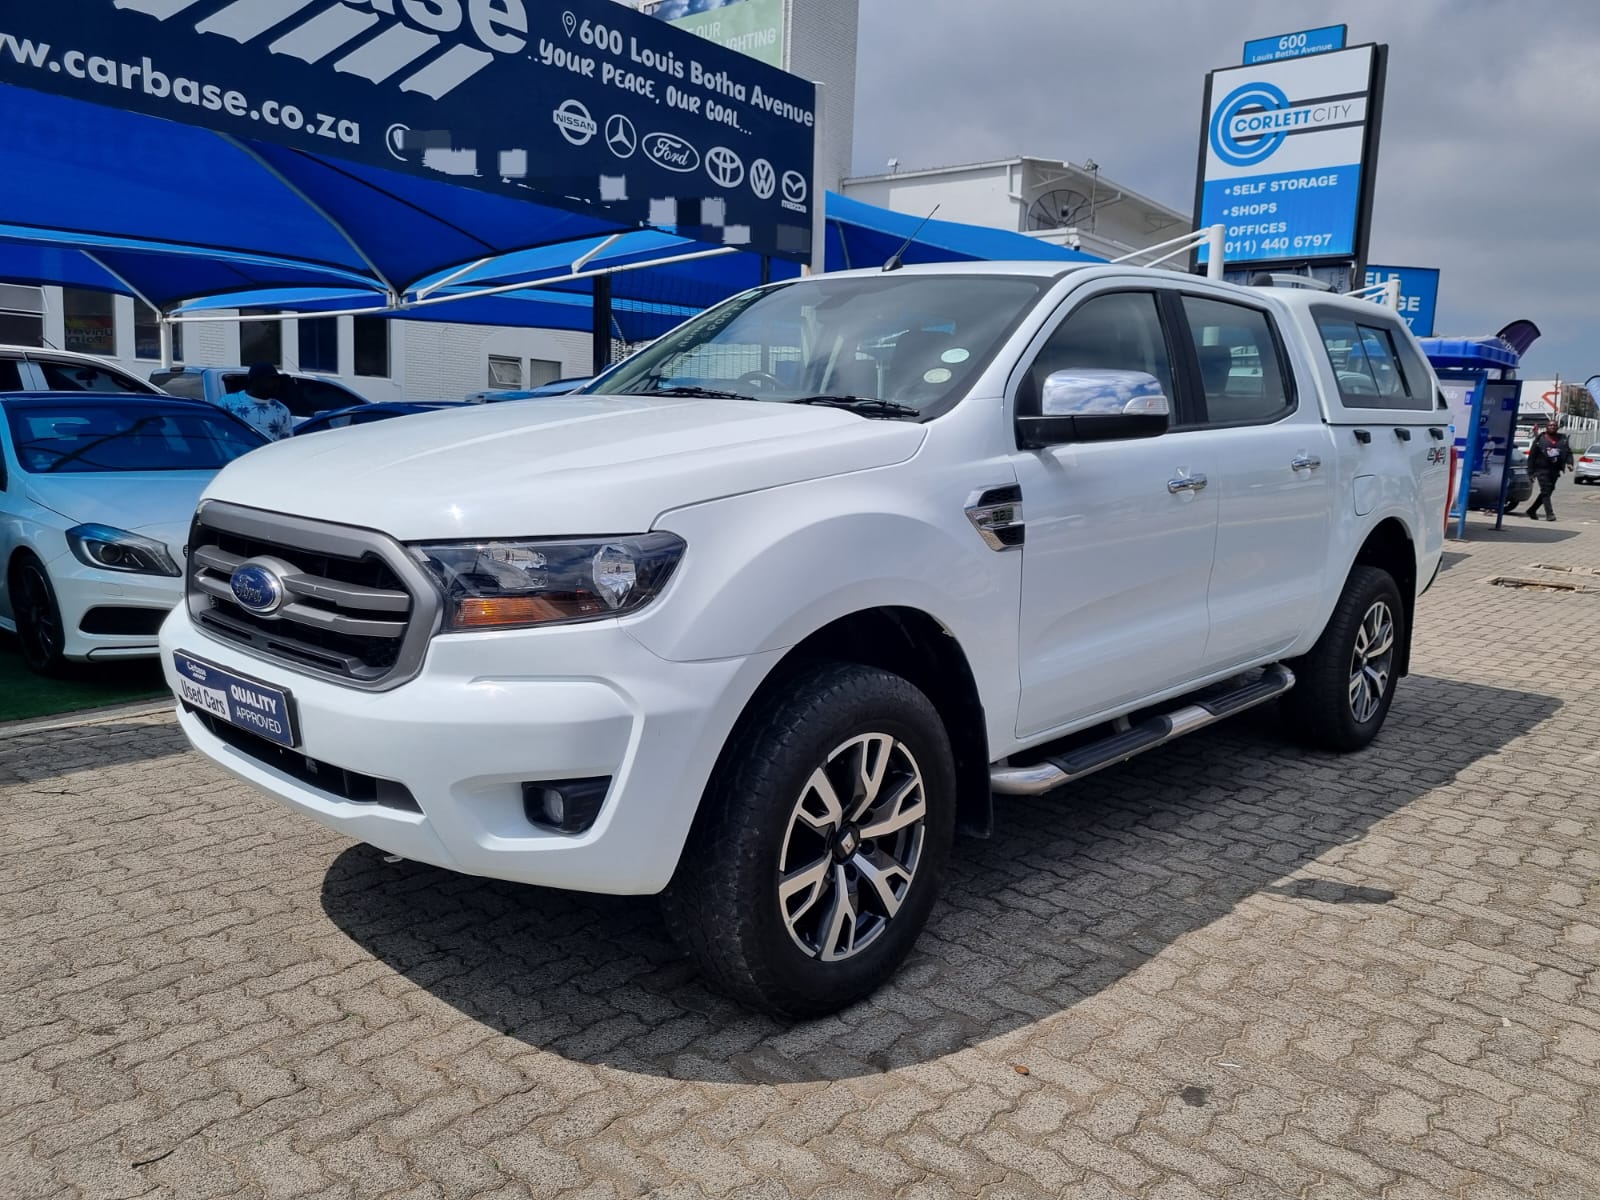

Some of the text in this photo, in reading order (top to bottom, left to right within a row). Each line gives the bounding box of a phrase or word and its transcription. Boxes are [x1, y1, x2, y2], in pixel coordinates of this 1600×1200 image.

[725, 27, 777, 51] IGHTING
[1278, 33, 1307, 50] 600
[1251, 43, 1333, 63] Louis Botha Avenue
[579, 19, 814, 127] 600 Louis Botha Avenue
[0, 32, 361, 145] w.carbase.co.za
[601, 61, 660, 105] PEACE,
[665, 84, 702, 113] OUR
[555, 112, 596, 132] NISSAN
[652, 137, 691, 166] Ford
[1232, 174, 1339, 196] SELF STORAGE
[1230, 202, 1278, 217] SHOPS
[1228, 221, 1287, 237] OFFICES
[1224, 233, 1333, 254] 011) 440 6797
[235, 573, 263, 603] Ford
[180, 679, 226, 715] Used Cars
[230, 684, 277, 715] QUALITY
[236, 705, 282, 734] APPROVED
